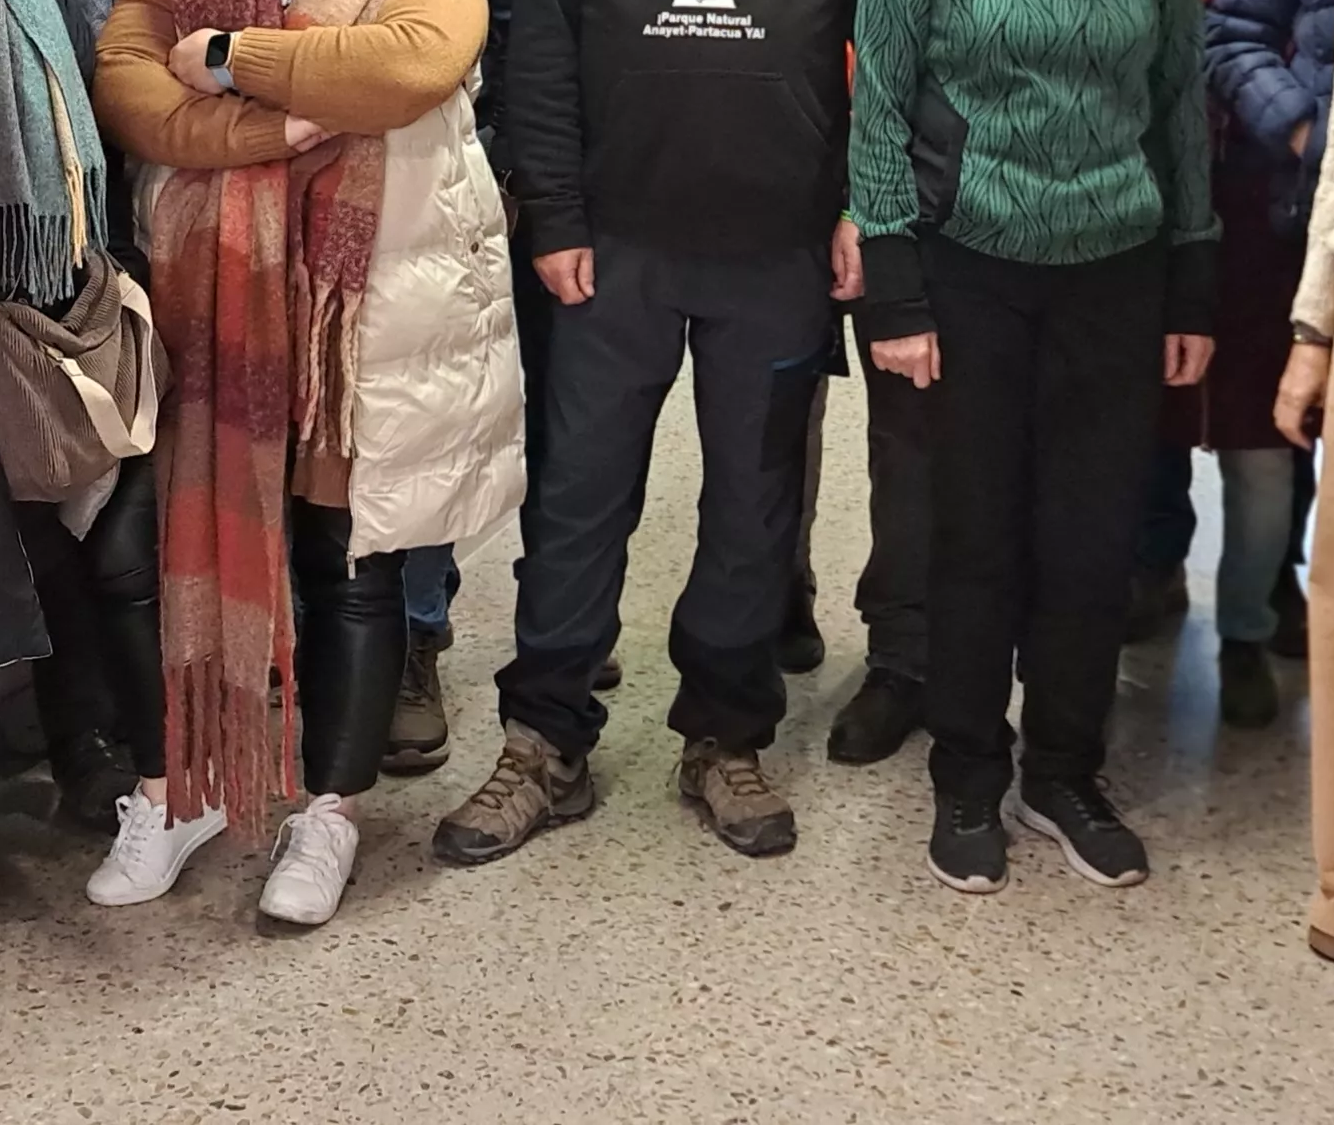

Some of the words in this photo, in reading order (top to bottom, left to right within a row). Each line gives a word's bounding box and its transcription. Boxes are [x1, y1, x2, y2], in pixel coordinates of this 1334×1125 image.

[657, 12, 703, 26] ¡Parque
[706, 13, 751, 25] Natural
[643, 25, 741, 39] Anayet-Partacua
[745, 27, 765, 39] YA!
